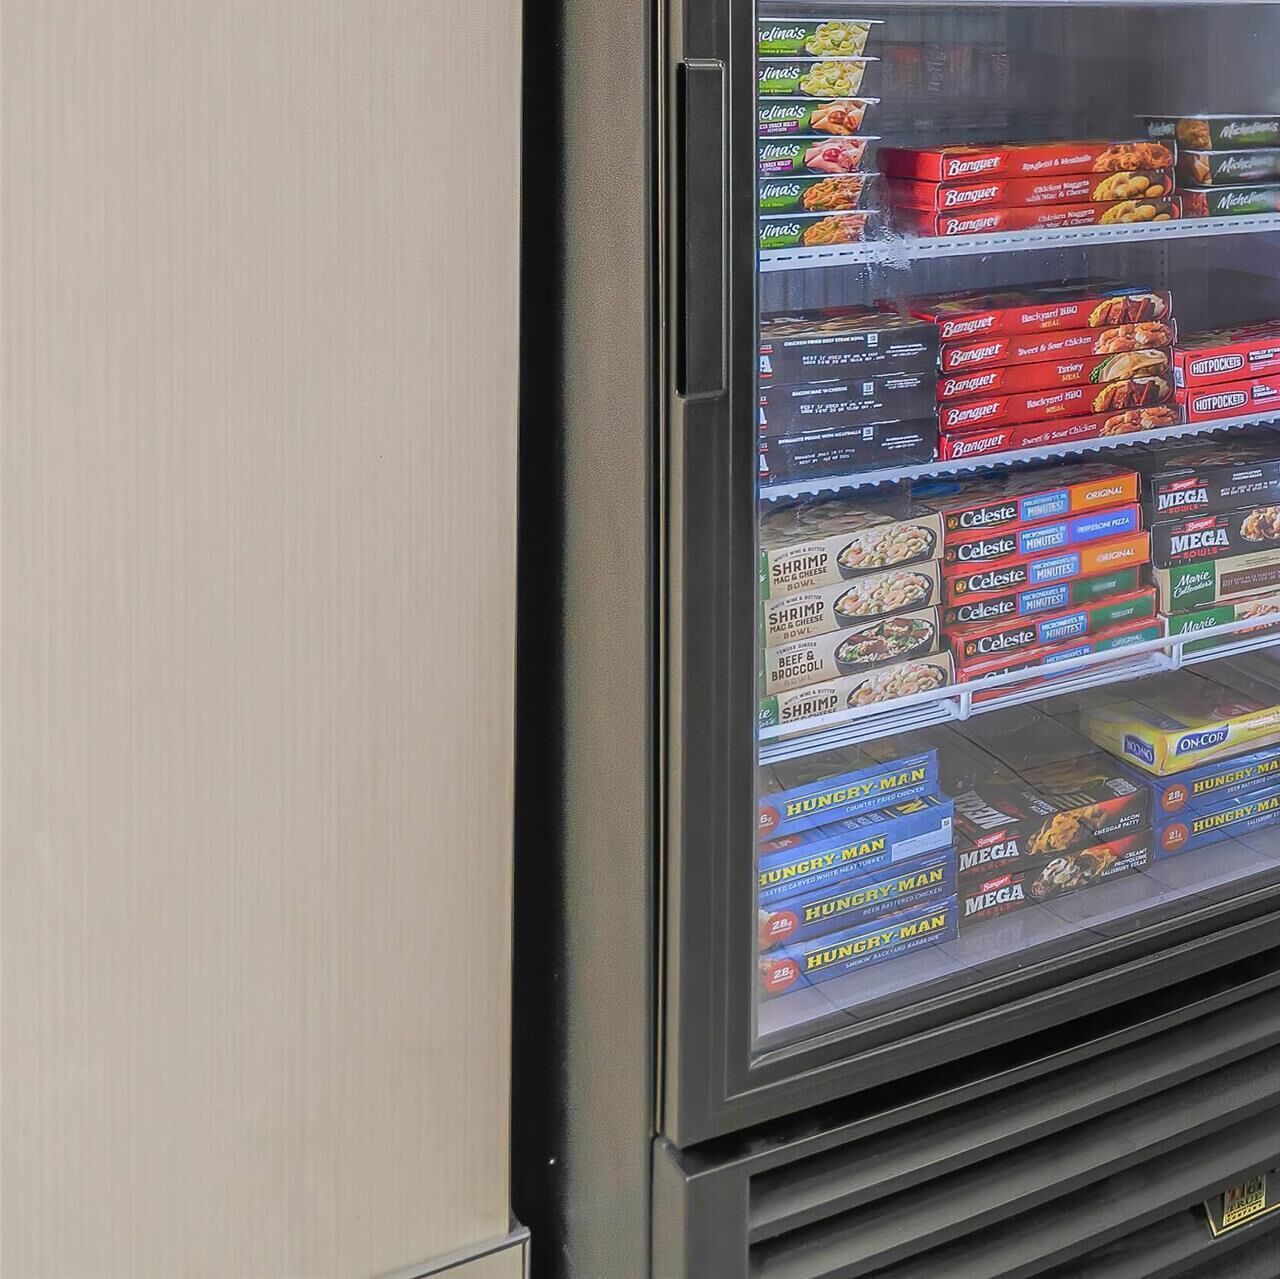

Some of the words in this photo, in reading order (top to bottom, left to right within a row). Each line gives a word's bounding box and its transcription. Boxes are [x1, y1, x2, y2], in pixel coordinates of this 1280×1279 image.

[947, 156, 1002, 176] Banquet
[944, 186, 1000, 206] Banquet
[946, 215, 1000, 235] Banquet
[1021, 308, 1059, 324] Backyard
[1060, 305, 1078, 317] BBQ
[943, 315, 996, 338] Banquet
[1040, 321, 1061, 329] MEAL
[950, 343, 1003, 366] Banquet
[1018, 347, 1039, 357] Sweet
[1039, 345, 1046, 353] &
[1047, 341, 1065, 352] Sour
[1065, 336, 1092, 349] Chicken
[1056, 363, 1084, 375] Turkey
[1061, 373, 1080, 382] MEAL
[943, 373, 997, 396] Banquet
[1026, 394, 1063, 410] Backyard
[1063, 389, 1082, 402] BBQ
[947, 402, 1000, 425] Banquet
[1022, 435, 1042, 446] Sweet
[1051, 429, 1068, 441] Sour
[1069, 423, 1097, 438] Chicken
[952, 434, 1006, 457] Banquet
[1086, 486, 1124, 500] ORIGINAL
[1158, 488, 1209, 511] MEGA
[961, 506, 1018, 528] Celeste
[1027, 501, 1064, 518] MINUTES!
[1111, 518, 1130, 527] PIZZA
[958, 538, 1016, 561] Celeste
[1026, 534, 1064, 551] MINUTES!
[1170, 528, 1230, 555] MEGA
[772, 553, 828, 577] SHRIMP
[1036, 562, 1075, 581] MINUTES!
[774, 575, 790, 586] MAC
[799, 566, 828, 579] CHEESE
[787, 579, 816, 592] BOWL
[968, 569, 1026, 591] Celeste
[1174, 572, 1211, 588] Marie
[958, 600, 1015, 622] Celeste
[1026, 595, 1064, 611] MINUTES!
[769, 602, 824, 625] SHRIMP
[1041, 617, 1077, 630] MICROWAVES
[769, 624, 786, 634] MAC
[795, 614, 824, 628] CHEESE
[783, 627, 813, 640] BOWL
[1045, 623, 1083, 640] MINUTES!
[1179, 616, 1217, 635] Marie
[978, 630, 1036, 653] Celeste
[779, 653, 803, 668] BEEF
[806, 650, 815, 661] &
[771, 659, 824, 682] BROCCOLI
[782, 695, 838, 719] SHRIMP
[1180, 731, 1224, 752] ON-COR
[787, 768, 925, 818] HUNGRY-MAN
[845, 799, 875, 814] COUNTRY
[876, 793, 896, 805] FRIED
[896, 786, 925, 798] CHICKEN
[1119, 813, 1140, 823] BACON
[977, 833, 1004, 848] Banquet
[1093, 824, 1123, 837] CHEDDAR
[959, 840, 1020, 873] MEGA
[1114, 854, 1148, 867] PROVOLONE
[1125, 848, 1148, 859] CREAMY
[788, 875, 815, 890] CARVED
[816, 869, 839, 881] WHITE
[856, 855, 885, 870] TURKEY
[1101, 865, 1130, 877] SALISBURY
[1130, 859, 1148, 869] STEAK
[805, 868, 944, 922] HUNGRY-MAN
[983, 877, 1010, 893] Banquet
[880, 896, 914, 913] BATTERED
[914, 886, 943, 901] CHICKEN
[964, 883, 1024, 917] MEGA
[807, 914, 945, 970] HUNGRY-MAN
[872, 945, 906, 961] BACKYARD
[907, 933, 943, 951] BARBEQUE
